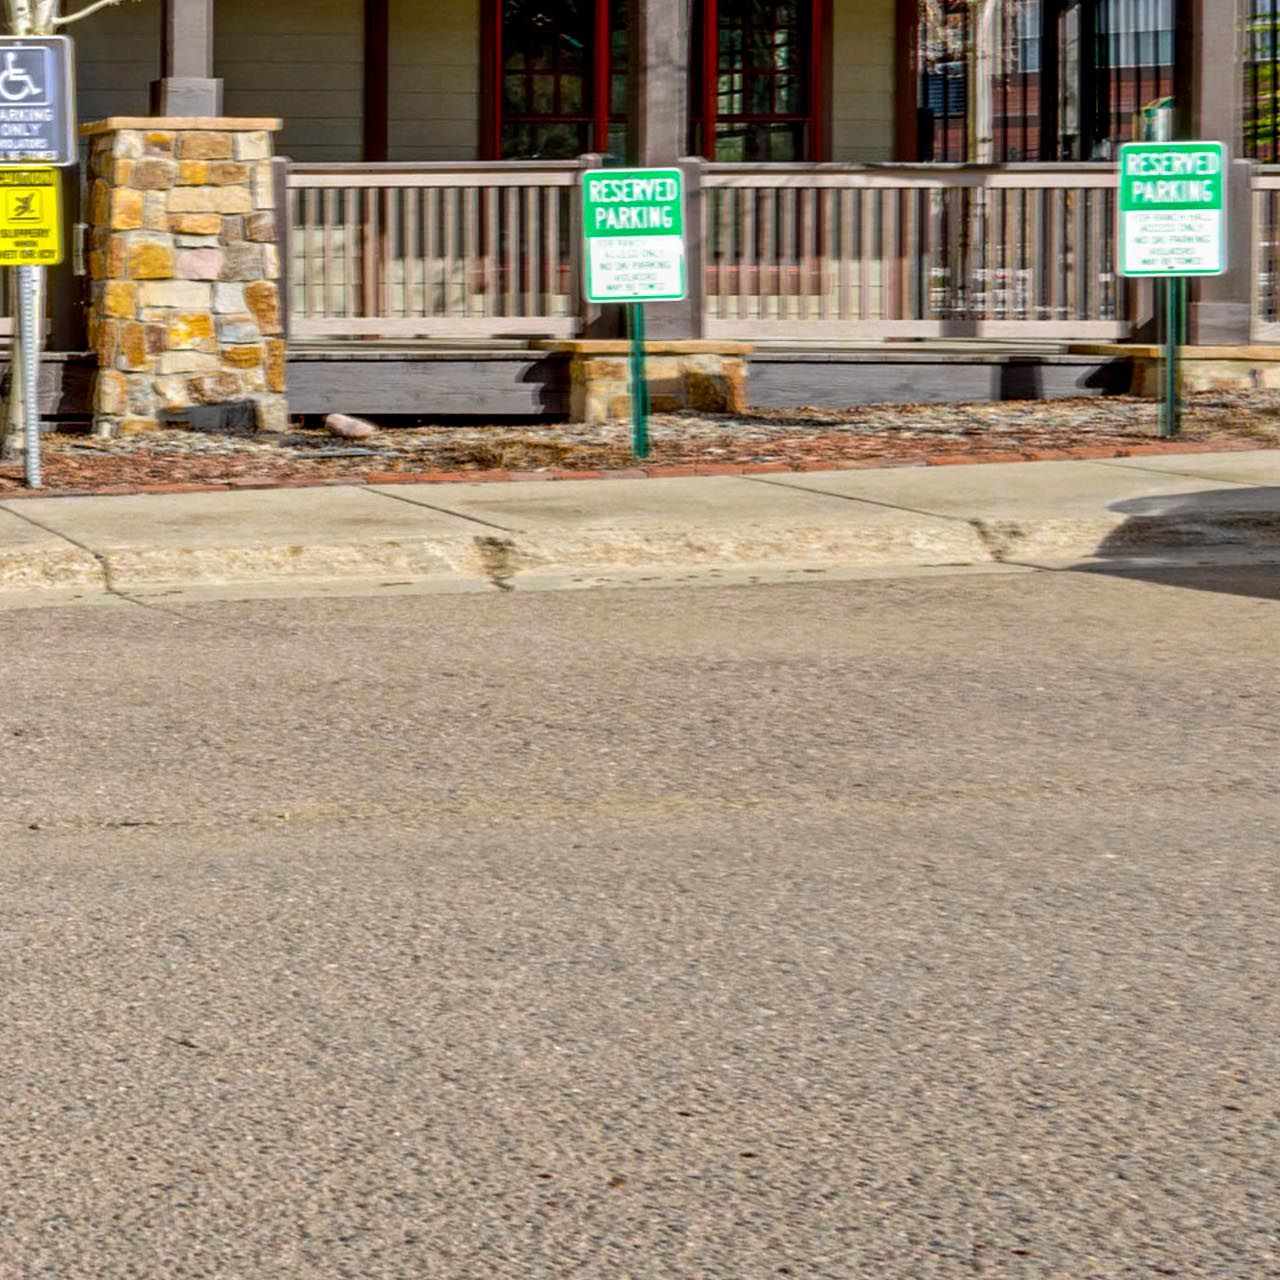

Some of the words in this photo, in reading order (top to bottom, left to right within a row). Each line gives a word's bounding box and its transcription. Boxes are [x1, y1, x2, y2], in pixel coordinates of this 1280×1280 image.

[1126, 152, 1220, 176] RESERVED
[589, 178, 678, 202] RESERVED
[1132, 180, 1213, 203] PARKING
[595, 206, 673, 230] PARKING
[0, 228, 51, 238] SLIPPERY
